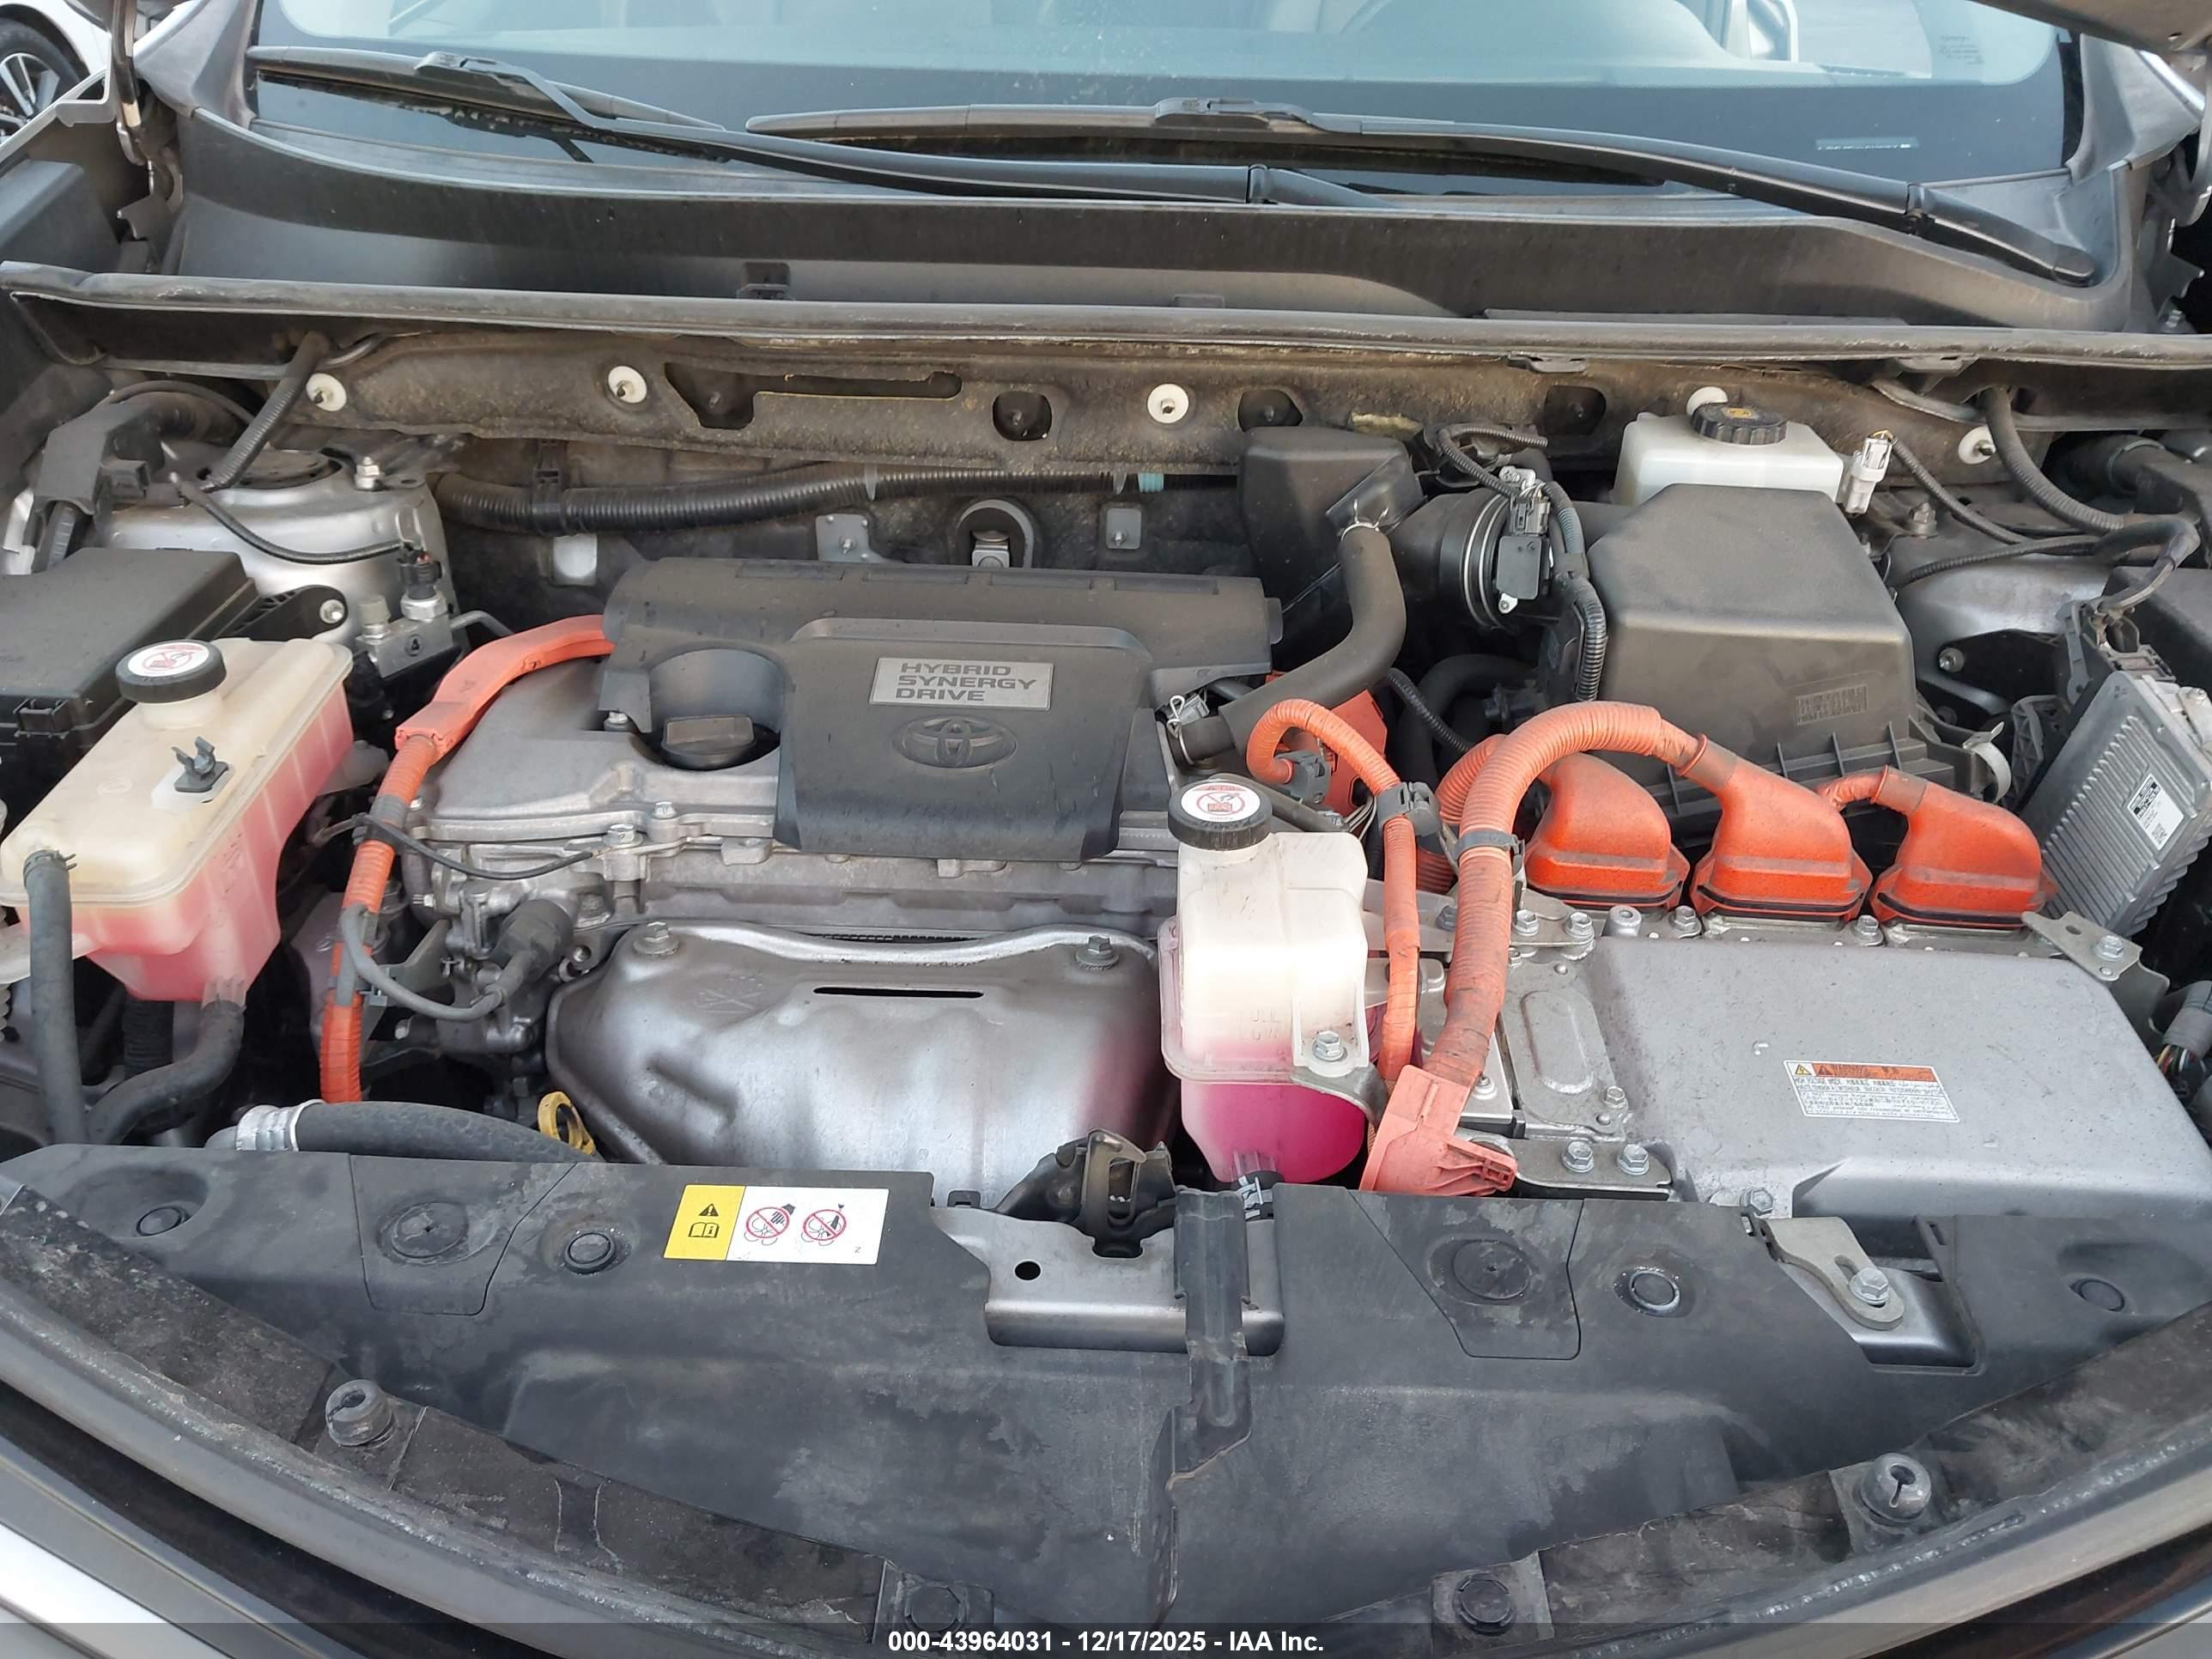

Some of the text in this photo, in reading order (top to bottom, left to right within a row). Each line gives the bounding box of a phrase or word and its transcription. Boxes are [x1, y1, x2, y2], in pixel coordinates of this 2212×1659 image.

[900, 662, 1012, 676] HYBRID
[897, 675, 1038, 690] SYNERGY
[895, 688, 986, 702] DRIVE
